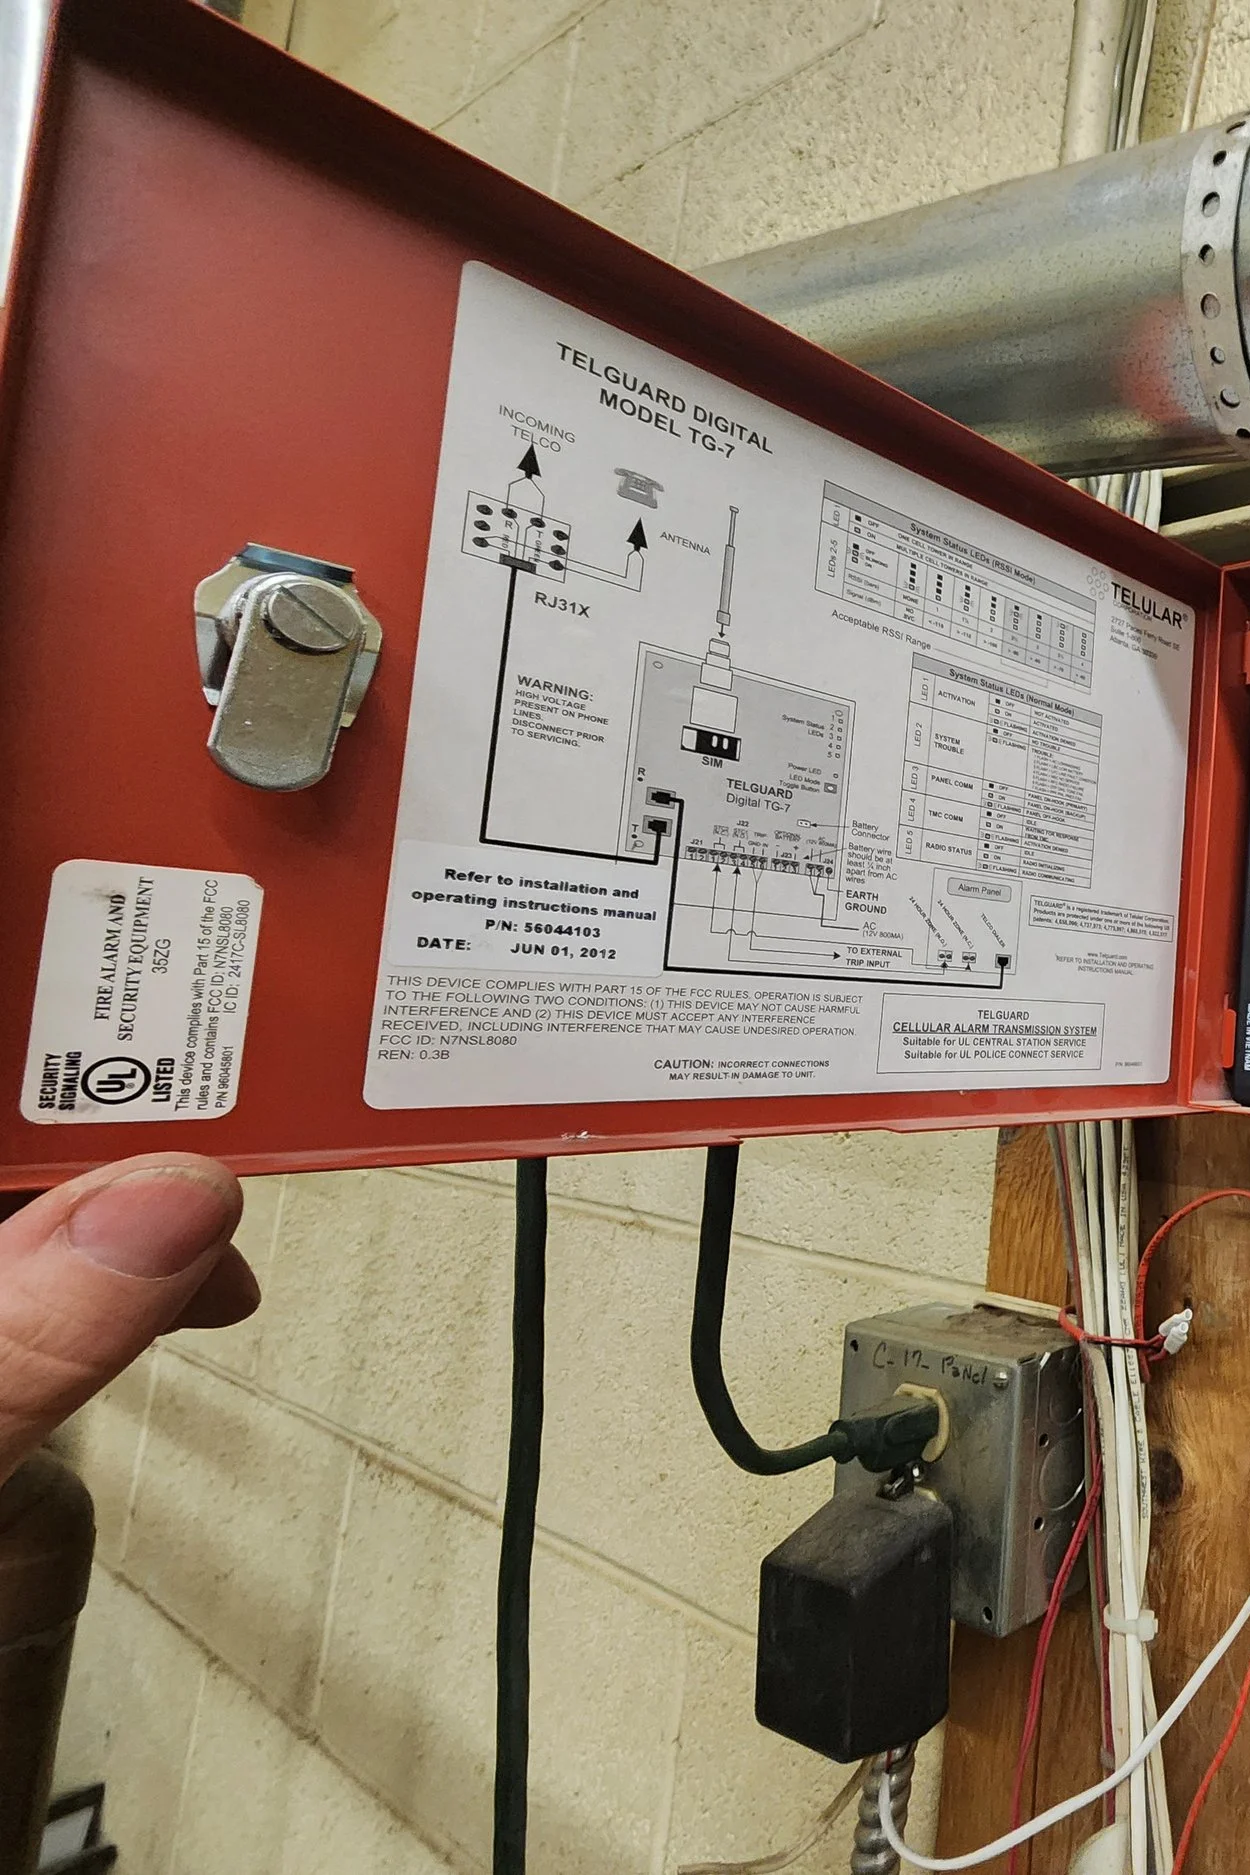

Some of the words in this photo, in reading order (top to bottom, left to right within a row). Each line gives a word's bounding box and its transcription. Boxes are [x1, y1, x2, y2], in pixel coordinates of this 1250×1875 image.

[556, 341, 686, 414] TELGUARD
[693, 406, 773, 454] DIGITAL
[499, 405, 576, 444] INCOMING
[599, 388, 681, 438] MODEL
[689, 427, 735, 458] TG-7
[512, 425, 561, 452] TELCO
[660, 531, 711, 555] ANTENNA
[534, 591, 590, 618] RJ31X
[1111, 581, 1182, 629] TELULAR
[831, 609, 880, 633] Acceptable
[882, 627, 903, 641] RSSI
[905, 635, 932, 650] Range
[517, 674, 594, 702] WARNING:
[950, 668, 978, 686] System
[980, 678, 1004, 693] Status
[1006, 686, 1024, 700] LEDs
[516, 689, 540, 700] HIGH
[542, 695, 586, 710] VOLTAGE
[938, 690, 976, 707] ACTIVATION
[702, 756, 723, 769] SIM
[726, 778, 793, 800] TELGUARD
[931, 775, 953, 787] PANEL
[955, 780, 973, 791] COMM
[726, 793, 761, 809] Digital
[765, 801, 791, 813] TG-7
[851, 820, 879, 833] Battery
[851, 828, 890, 842] Connector
[203, 880, 218, 903] FCC
[444, 868, 492, 884] Refer
[497, 875, 513, 886] to
[519, 877, 608, 896] installation
[612, 888, 639, 899] and
[846, 890, 879, 901] EARTH
[958, 883, 980, 894] Alarm
[981, 885, 1002, 897] Panel
[110, 893, 126, 928] AND
[201, 906, 215, 922] the
[411, 890, 497, 909] operating
[503, 896, 598, 916] instructions
[603, 908, 656, 921] manual
[845, 902, 887, 915] GROUND
[128, 876, 154, 965] EQUIPMENT
[200, 924, 213, 936] of
[485, 919, 518, 933] P/N:
[524, 922, 601, 938] 56044103
[197, 938, 211, 950] 15
[213, 907, 233, 968] N7NSL8080
[228, 900, 250, 977] 2417C-SL8080
[417, 936, 471, 951] DATE:
[510, 943, 545, 956] JUN
[550, 946, 574, 959] 01,
[580, 948, 616, 959] 2012
[100, 929, 121, 984] ALARM
[152, 938, 171, 974] 35ZG
[193, 954, 208, 975] Part
[190, 978, 206, 1000] with
[210, 972, 225, 986] ID:
[225, 984, 240, 998] ID:
[387, 975, 422, 987] THIS
[427, 977, 481, 989] DEVICE
[486, 980, 555, 992] COMPLIES
[559, 983, 591, 993] WITH
[595, 984, 625, 995] PART
[631, 986, 643, 995] 15
[646, 987, 662, 996] OF
[665, 987, 687, 997] THE
[690, 988, 712, 998] FCC
[715, 989, 750, 1000] RULES.
[755, 991, 810, 1001] OPERATION
[812, 993, 821, 1002] IS
[823, 994, 863, 1004] SUBJECT
[94, 986, 113, 1020] FIRE
[117, 968, 141, 1041] SECURITY
[207, 989, 222, 1013] FCC
[223, 1002, 237, 1013] IC
[187, 1002, 202, 1048] complies
[978, 1010, 1030, 1021] TELGUARD
[204, 1016, 219, 1059] contains
[379, 1035, 412, 1046] FCC
[416, 1035, 435, 1046] ID:
[439, 1035, 517, 1046] N7NSL8080
[892, 1022, 951, 1033] CELLULAR
[954, 1023, 990, 1033] ALARM
[993, 1024, 1061, 1035] TRANSMISSION
[1063, 1026, 1097, 1036] SYSTEM
[218, 1046, 233, 1089] 96045801
[378, 1050, 415, 1061] REN:
[419, 1050, 450, 1060] 0.3B
[654, 1060, 714, 1070] CAUTION:
[718, 1060, 770, 1068] INCORRECT
[772, 1060, 829, 1068] CONNECTIONS
[152, 1057, 175, 1102] LISTED
[179, 1051, 195, 1085] device
[200, 1062, 213, 1081] and
[38, 1052, 62, 1109] SECURITY
[58, 1051, 82, 1110] SIGNALING
[95, 1068, 137, 1093] UL
[175, 1088, 190, 1111] This
[196, 1085, 209, 1110] rules
[215, 1092, 228, 1108] P/N
